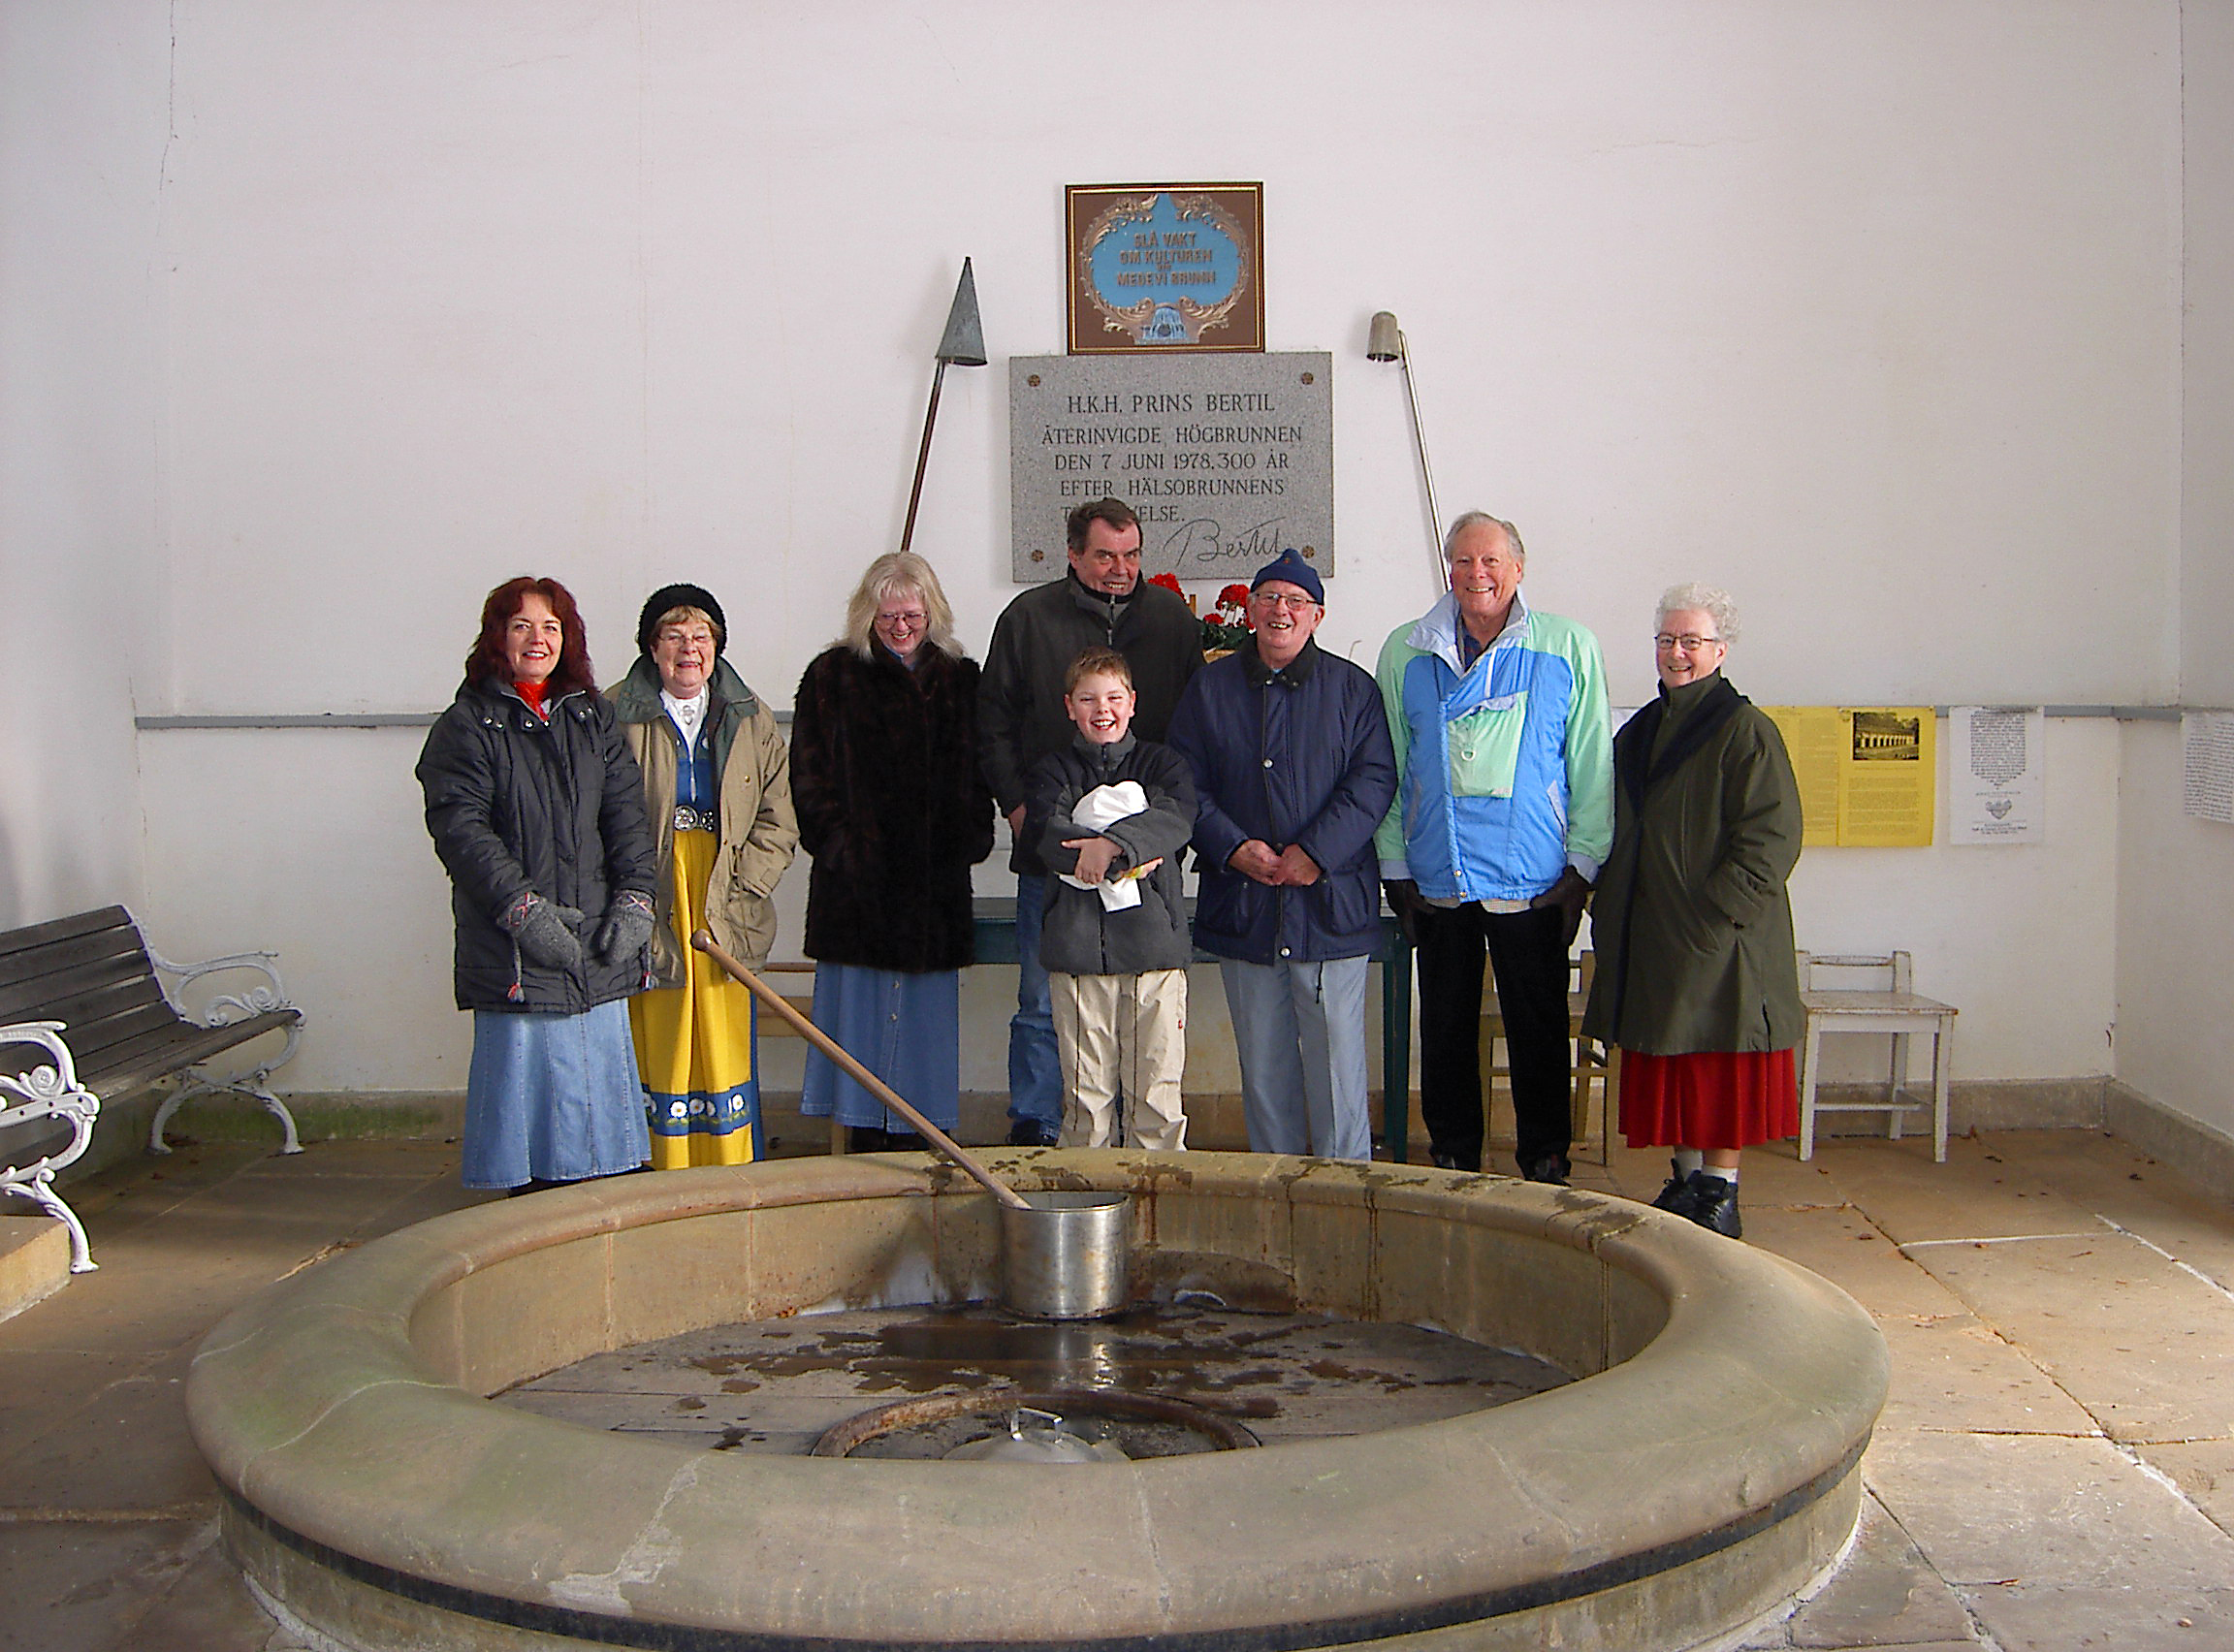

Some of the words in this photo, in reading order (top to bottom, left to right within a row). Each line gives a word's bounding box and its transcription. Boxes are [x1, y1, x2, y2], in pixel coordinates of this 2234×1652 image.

[1133, 230, 1159, 248] SLÅ
[1162, 232, 1197, 247] VAKT
[1119, 250, 1140, 265] OM
[1145, 248, 1212, 264] KULTUREN
[1117, 272, 1167, 286] MEDEVI
[1171, 271, 1216, 285] BRUNN
[1068, 396, 1122, 413] H.K.H.
[1133, 395, 1193, 412] PRINS
[1206, 394, 1275, 412] BERTIL
[1041, 425, 1162, 444] ÅTERINVIGDE
[1176, 424, 1301, 443] HÖGBRUNNEN
[1055, 454, 1091, 470] DEN
[1101, 453, 1111, 470] 7
[1121, 453, 1165, 470] JUNI
[1266, 449, 1289, 469] ÅR
[1061, 480, 1113, 496] EFTER
[1129, 478, 1284, 495] HÄLSOBRUNNENS
